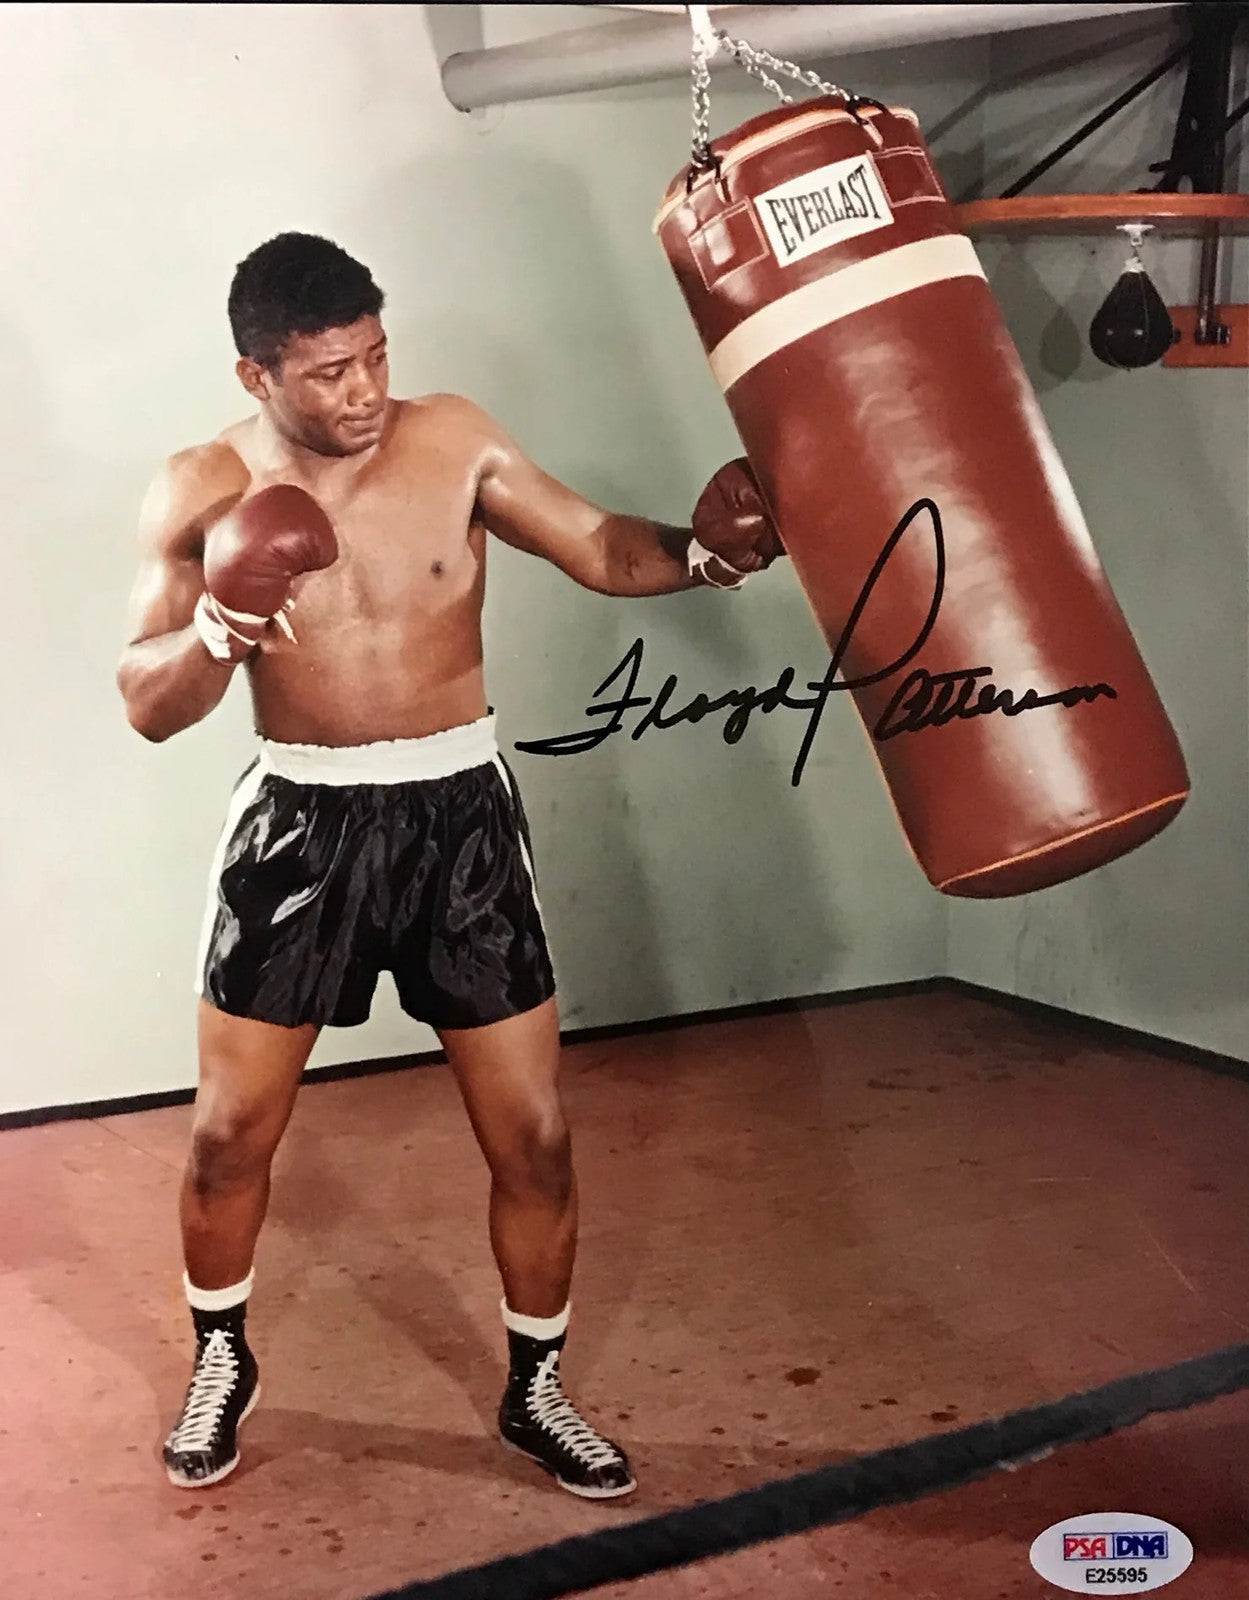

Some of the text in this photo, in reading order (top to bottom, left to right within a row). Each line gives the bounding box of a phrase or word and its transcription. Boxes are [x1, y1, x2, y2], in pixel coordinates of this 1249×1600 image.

[765, 164, 882, 256] EVERLAST
[515, 638, 802, 756] Floyd
[1065, 1535, 1165, 1559] PSA DNA
[1085, 1567, 1148, 1584] E25595
